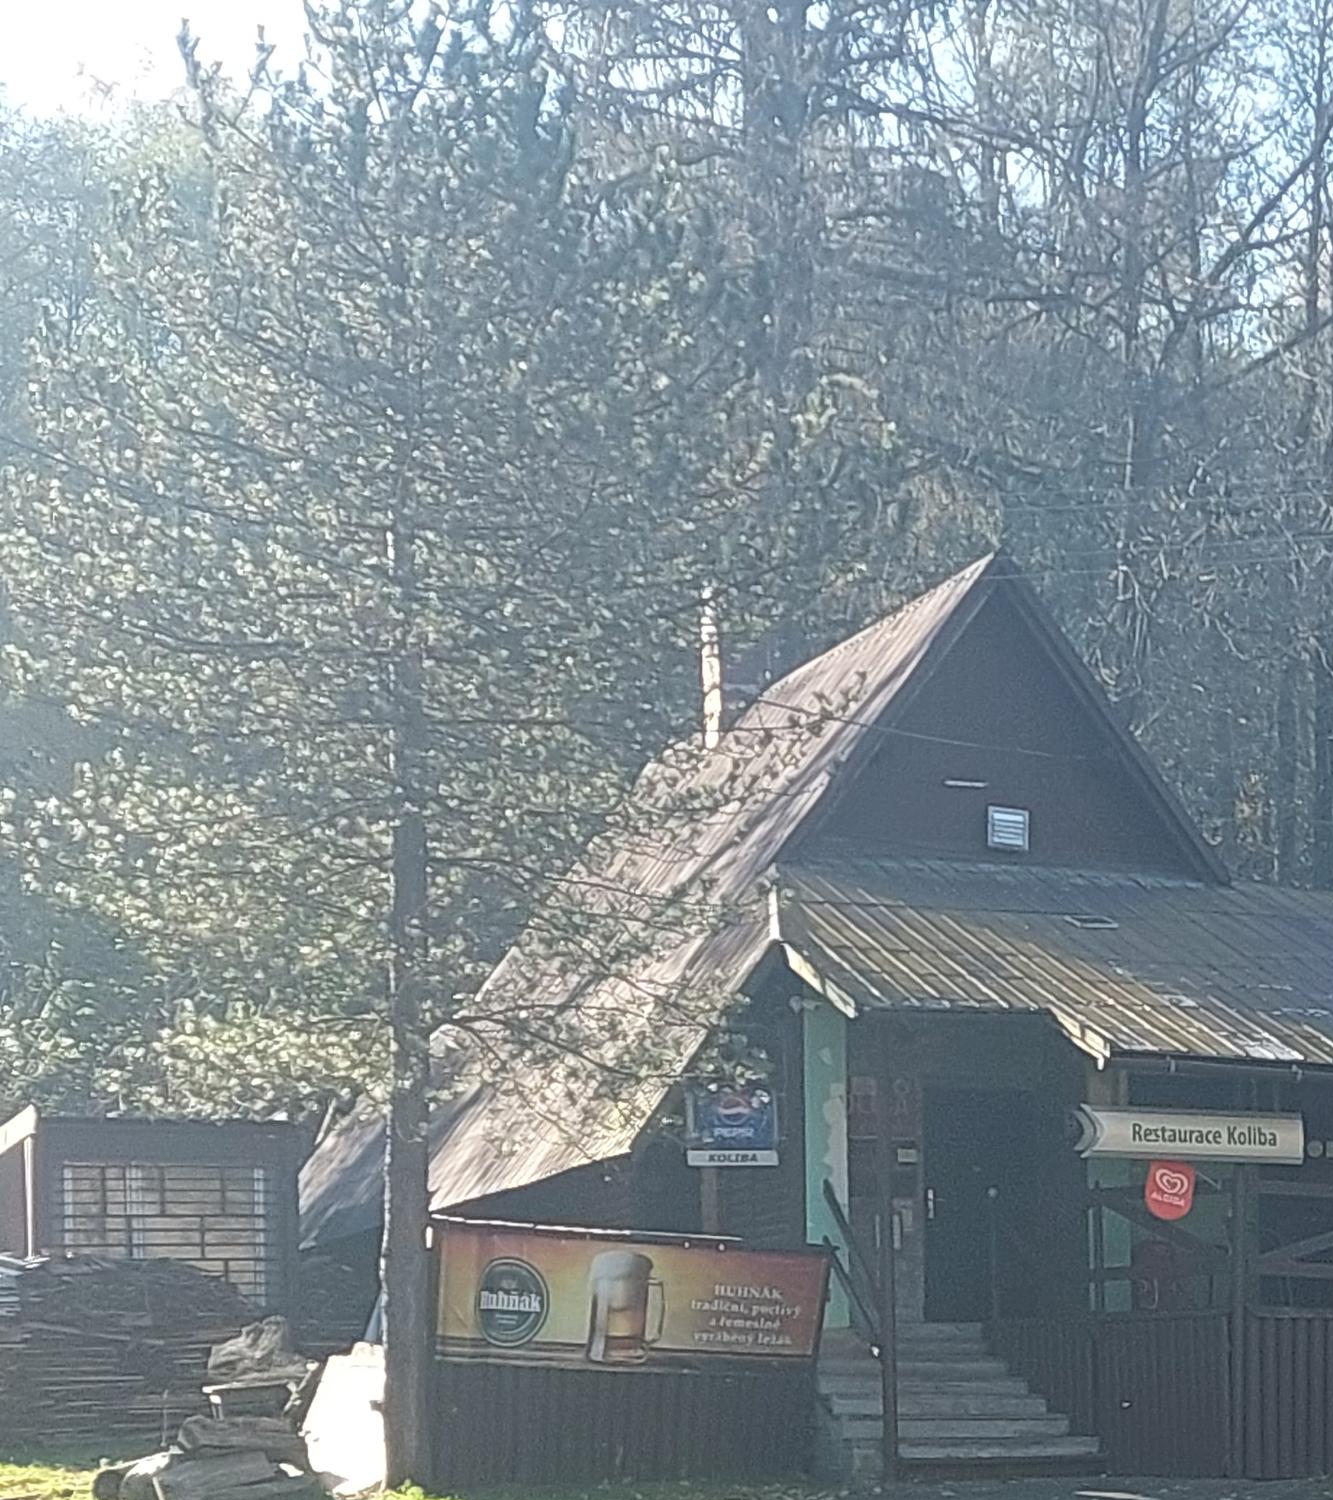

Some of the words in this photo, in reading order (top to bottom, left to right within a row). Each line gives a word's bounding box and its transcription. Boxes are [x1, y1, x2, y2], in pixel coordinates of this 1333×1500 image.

[1132, 1123, 1222, 1145] Restaurace
[1227, 1125, 1277, 1147] Koliba
[708, 1153, 758, 1163] KOLIBA
